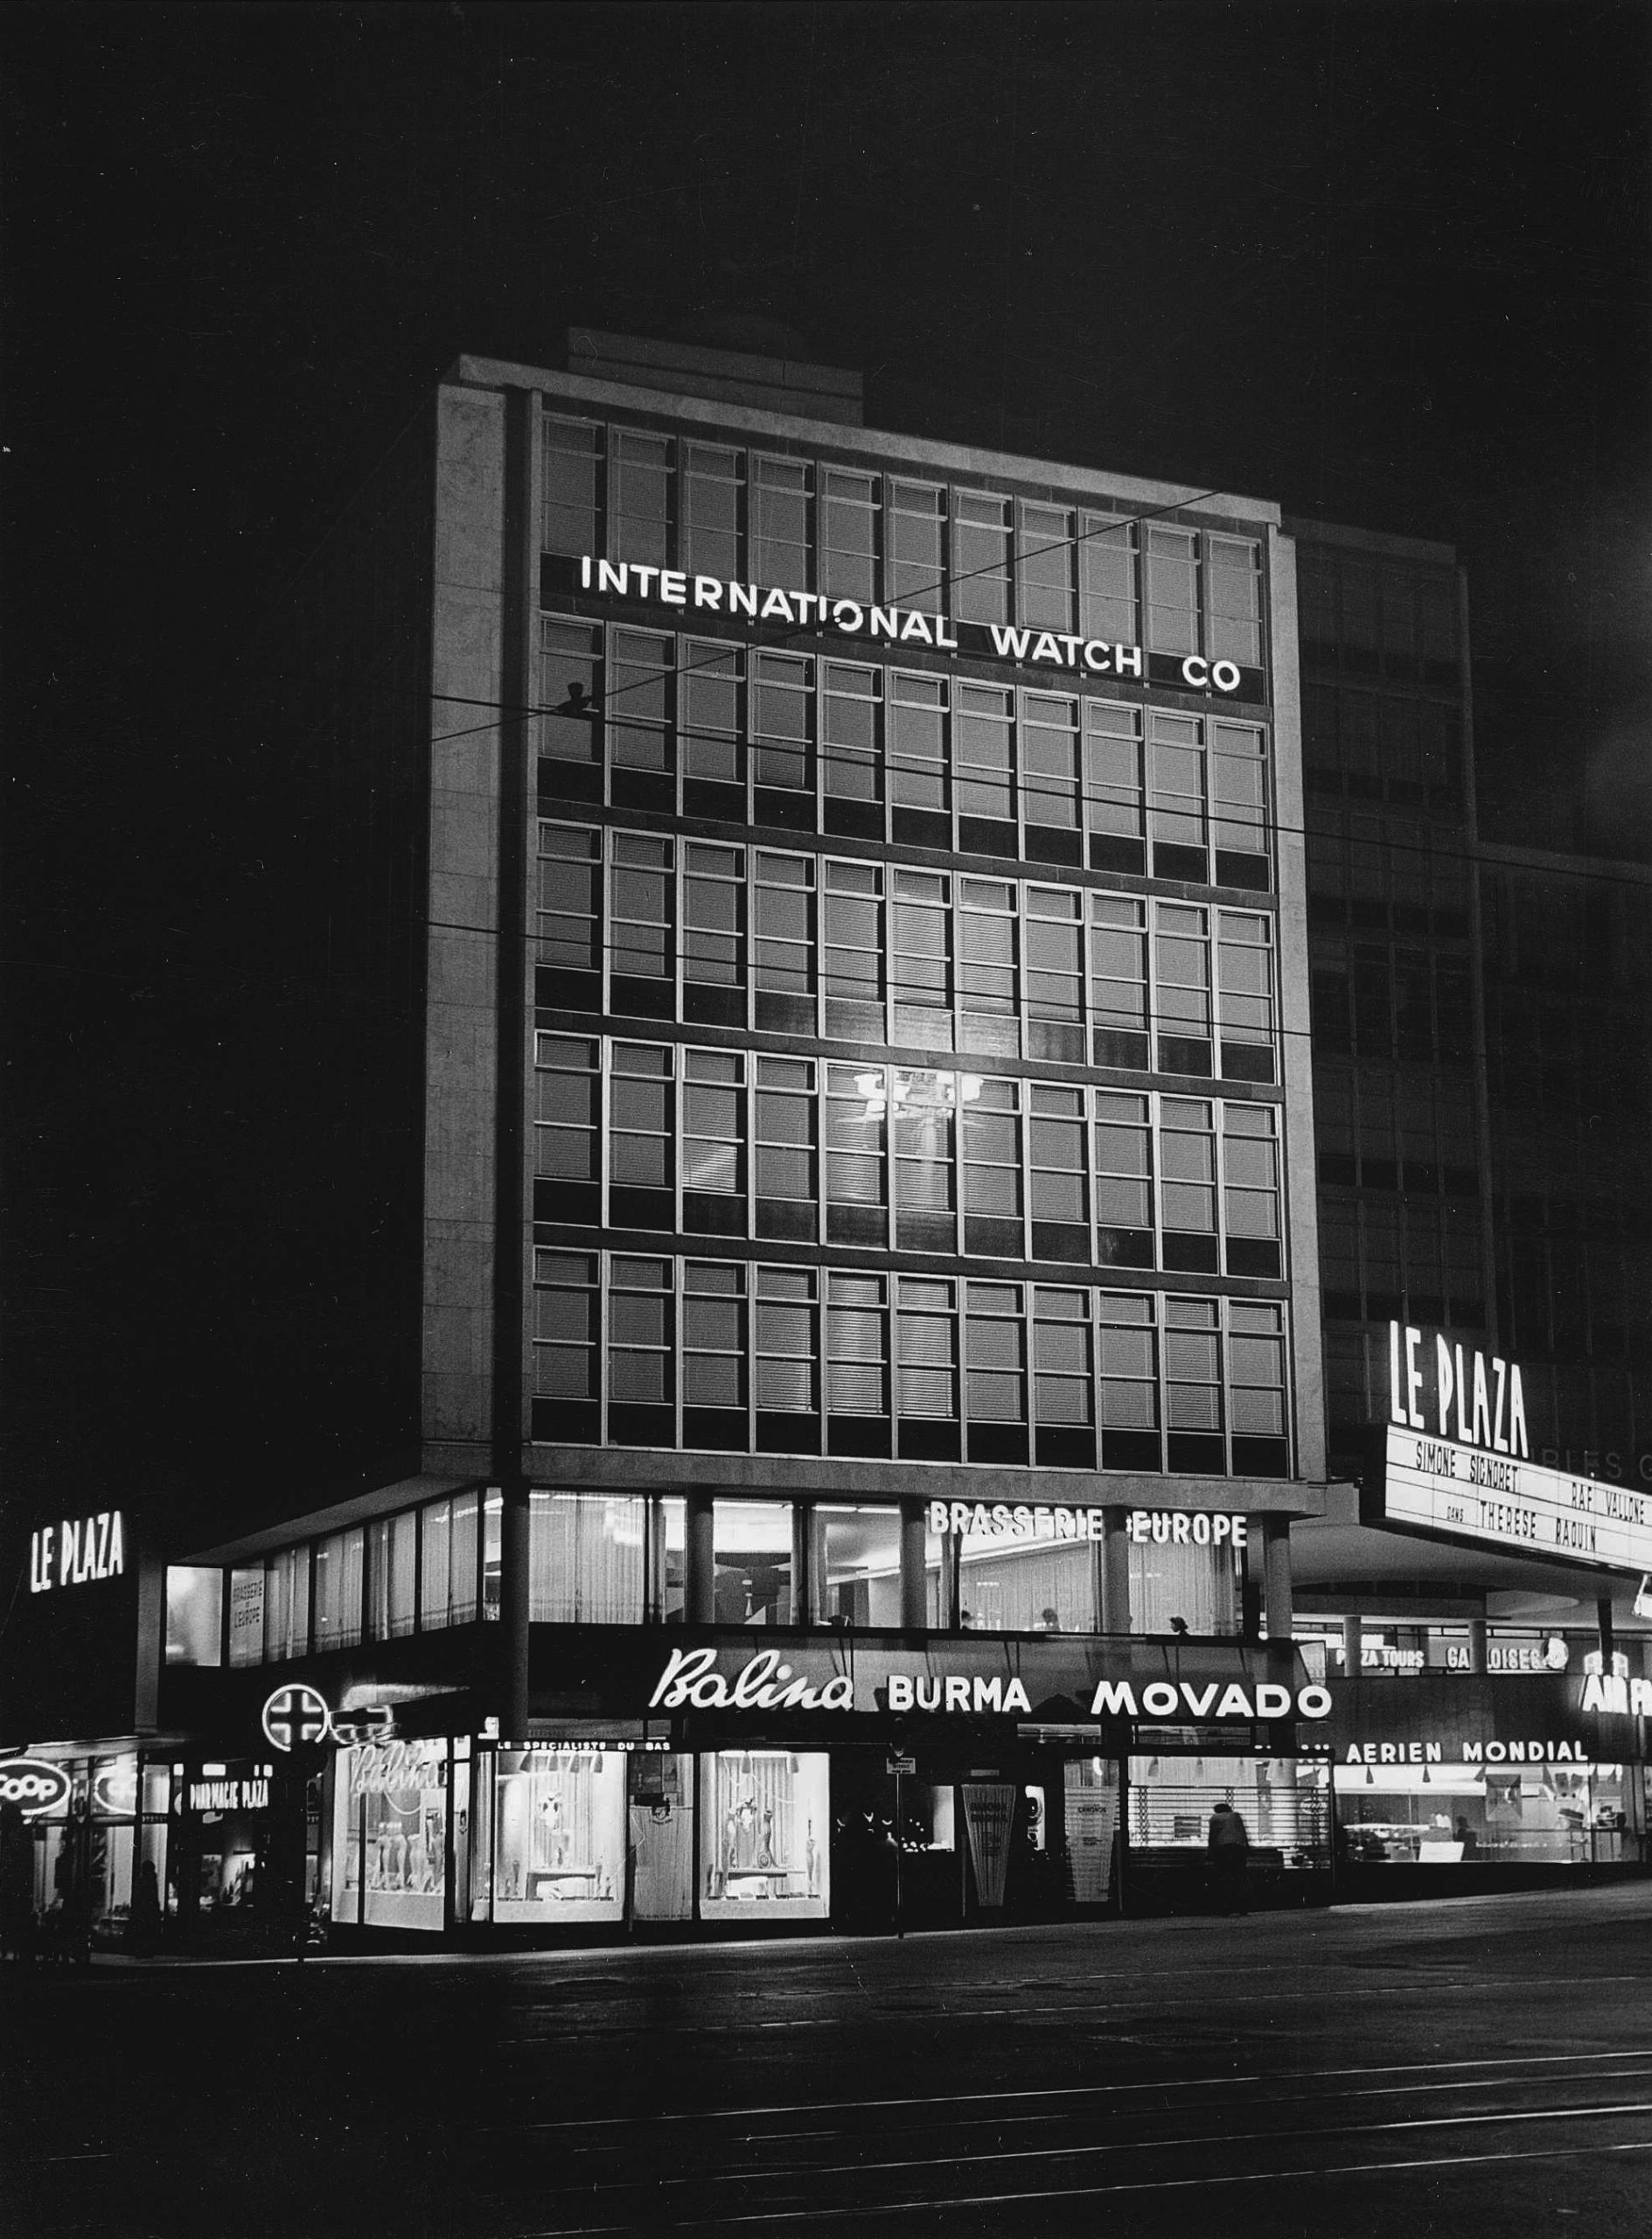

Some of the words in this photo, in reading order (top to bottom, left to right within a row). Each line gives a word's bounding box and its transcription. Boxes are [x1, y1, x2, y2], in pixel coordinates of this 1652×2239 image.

[581, 555, 958, 648] INTERNATIONAL
[989, 624, 1142, 677] WATCH
[1181, 655, 1241, 692] CO
[1389, 1320, 1425, 1429] LE
[1436, 1333, 1529, 1459] PLAZA
[1416, 1440, 1456, 1477] SIMONE
[1470, 1454, 1518, 1493] SIGNORET
[1572, 1482, 1593, 1511] RAF
[1605, 1490, 1644, 1525] VALLONE
[930, 1501, 1104, 1542] BRASSERIE
[1132, 1510, 1247, 1547] EUROPE
[1480, 1500, 1537, 1539] THERESE
[31, 1527, 53, 1593] LE
[60, 1510, 123, 1587] PLAZA
[648, 1648, 854, 1710] Balina
[886, 1674, 1032, 1712] BURMA
[1090, 1679, 1333, 1719] MOVADO
[1335, 1649, 1379, 1667] PZA
[1382, 1650, 1425, 1669] TOURS
[497, 1741, 512, 1750] LE
[523, 1741, 606, 1751] SPECIALISTE
[1346, 1741, 1442, 1763] AERIEN
[1462, 1740, 1589, 1762] MONDIAL
